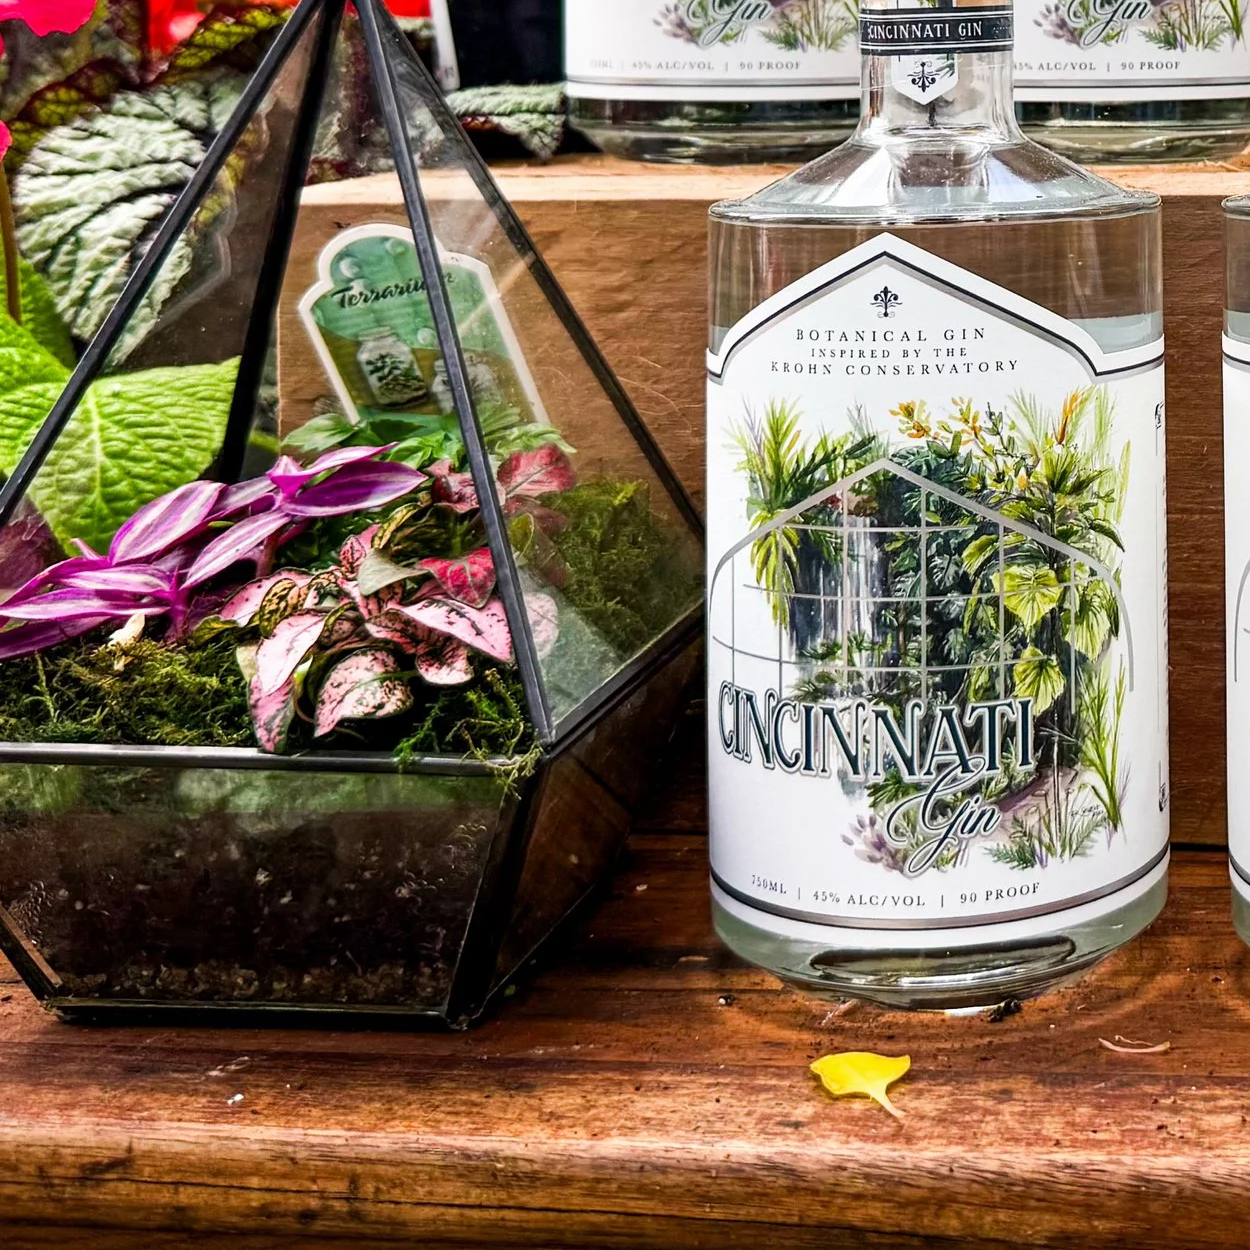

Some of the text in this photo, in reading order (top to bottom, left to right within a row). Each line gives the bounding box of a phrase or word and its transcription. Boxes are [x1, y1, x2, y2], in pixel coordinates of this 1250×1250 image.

[869, 20, 983, 40] CINCINNATI GIN
[656, 60, 714, 70] ALC/VOL
[739, 62, 753, 70] 90
[758, 61, 802, 70] PROOF
[1038, 61, 1096, 71] ALC/VOL
[1121, 61, 1134, 70] 90
[1140, 60, 1181, 70] PROOF
[796, 327, 985, 342] BOTANICAL GIN
[811, 347, 967, 359] INSPIRED BY THE
[771, 360, 1018, 376] KROHN CONSERVATORY
[719, 680, 1034, 778] CINCINNATI
[886, 756, 1001, 874] Gin
[751, 874, 1041, 907] 750ML 45% ALC/VOL 90 PROOF
